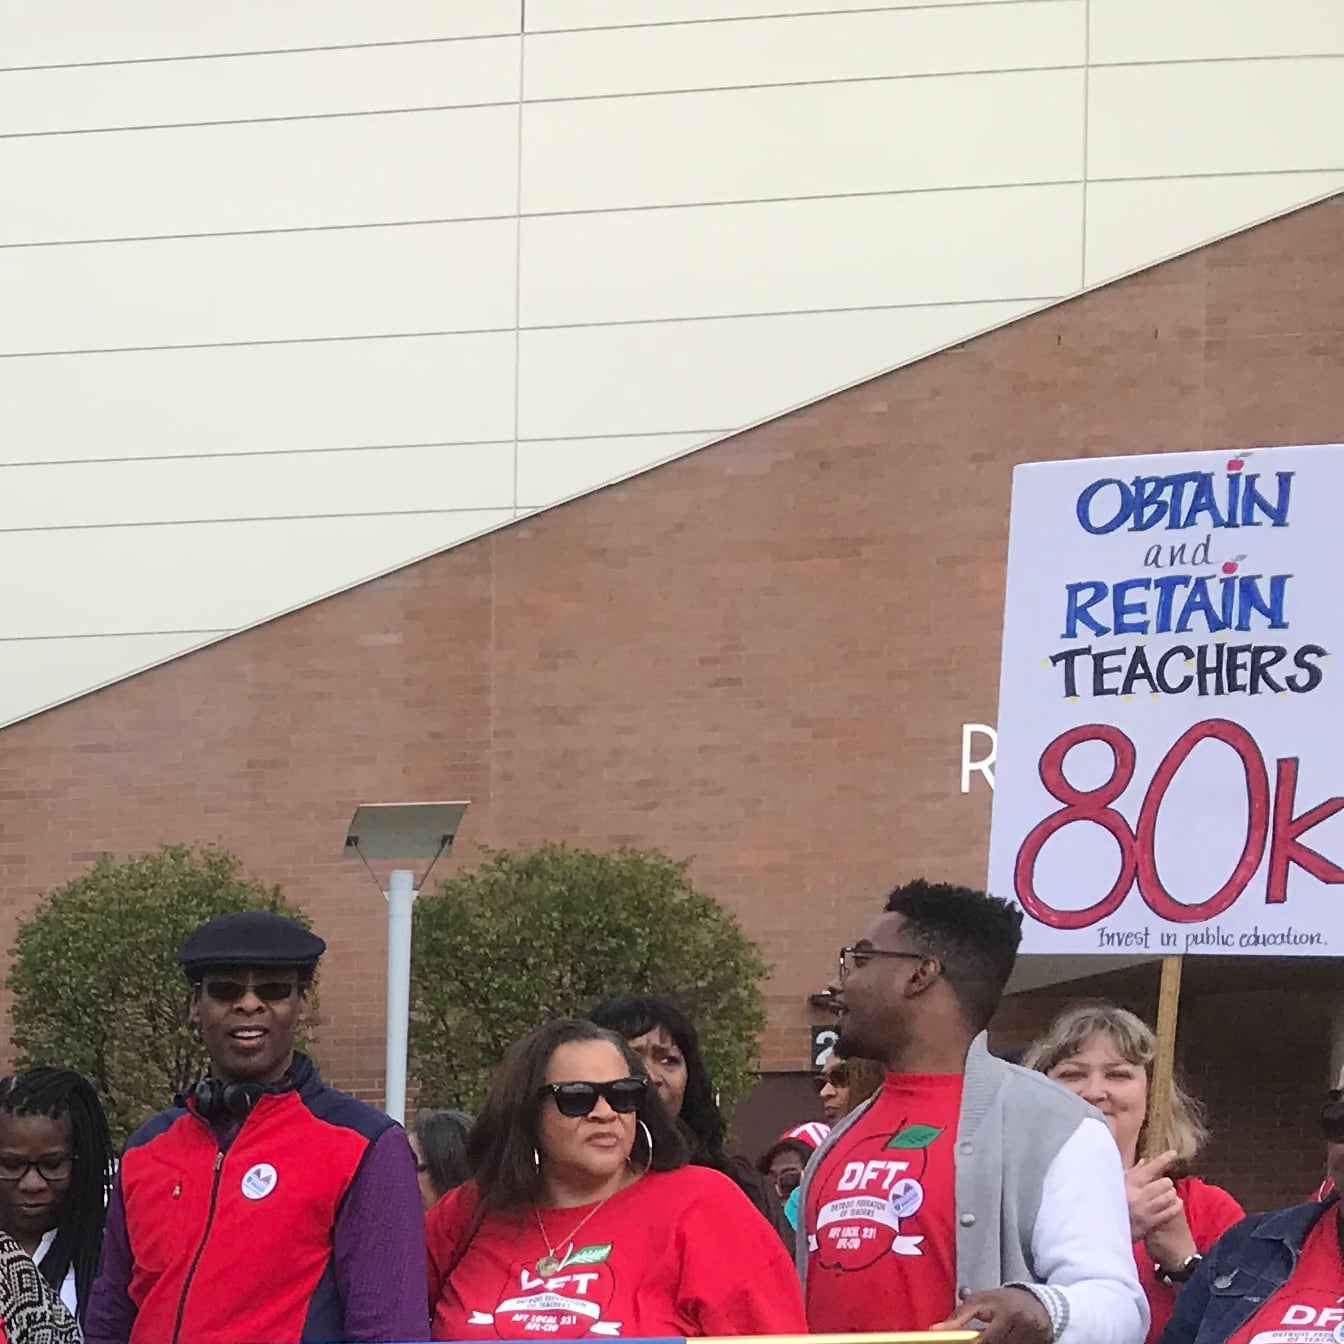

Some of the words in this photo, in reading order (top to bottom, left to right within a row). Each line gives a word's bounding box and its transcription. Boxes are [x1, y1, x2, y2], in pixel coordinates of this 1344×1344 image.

[1076, 468, 1296, 535] OBTAIN
[1143, 534, 1211, 569] and
[1060, 572, 1295, 639] RETAIN
[1048, 642, 1330, 698] TEACHERS
[1097, 926, 1151, 949] Invest
[1161, 931, 1177, 948] in
[1185, 926, 1235, 959] public
[1239, 925, 1328, 948] education.
[837, 1160, 910, 1191] DFT
[524, 1323, 560, 1333] AFL-CIO
[530, 1314, 557, 1324] LOCAL
[560, 1315, 577, 1326] 231
